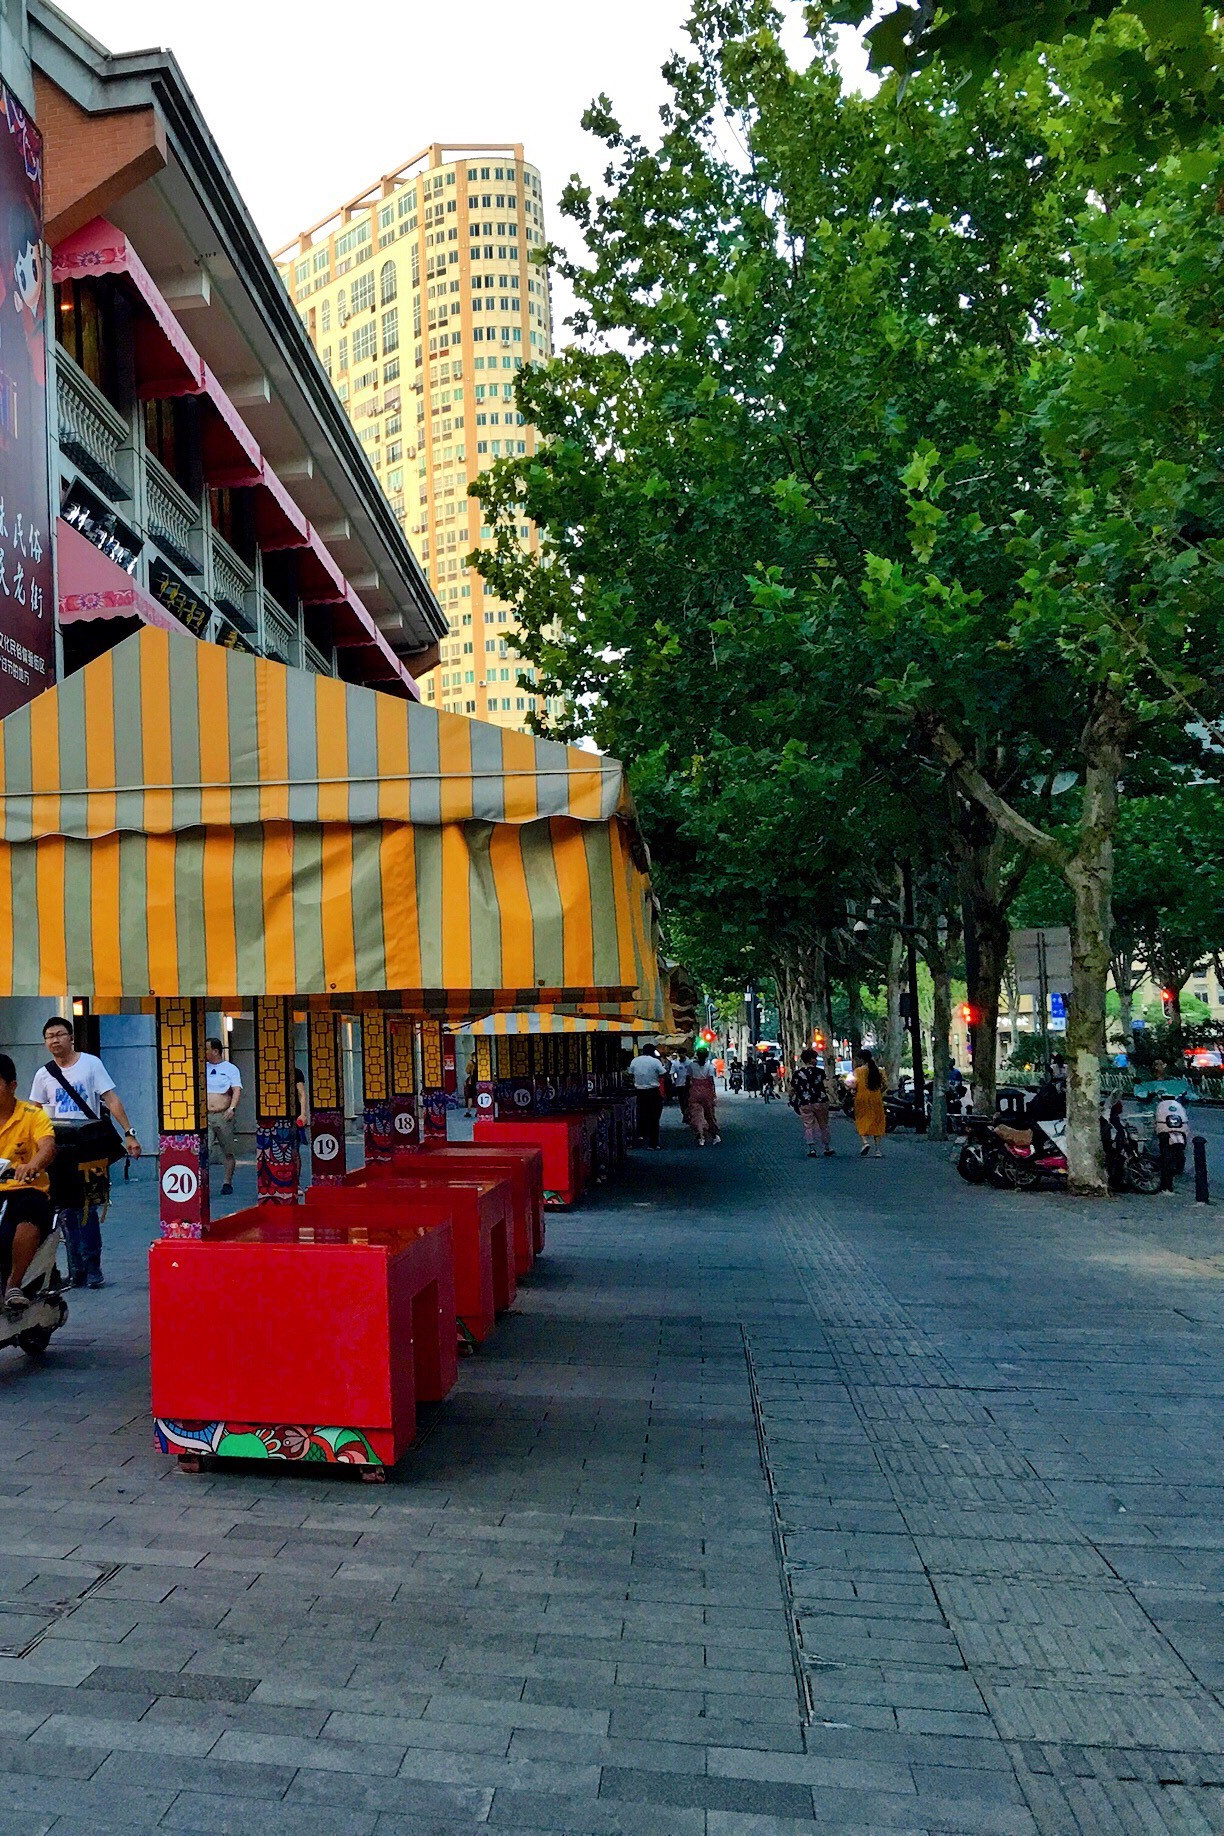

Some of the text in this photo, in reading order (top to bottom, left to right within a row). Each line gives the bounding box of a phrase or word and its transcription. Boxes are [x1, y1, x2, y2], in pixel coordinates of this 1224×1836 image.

[480, 1096, 490, 1105] 17
[517, 1092, 529, 1103] 16
[397, 1117, 413, 1130] 18
[317, 1139, 336, 1154] 19
[166, 1173, 193, 1194] 20
